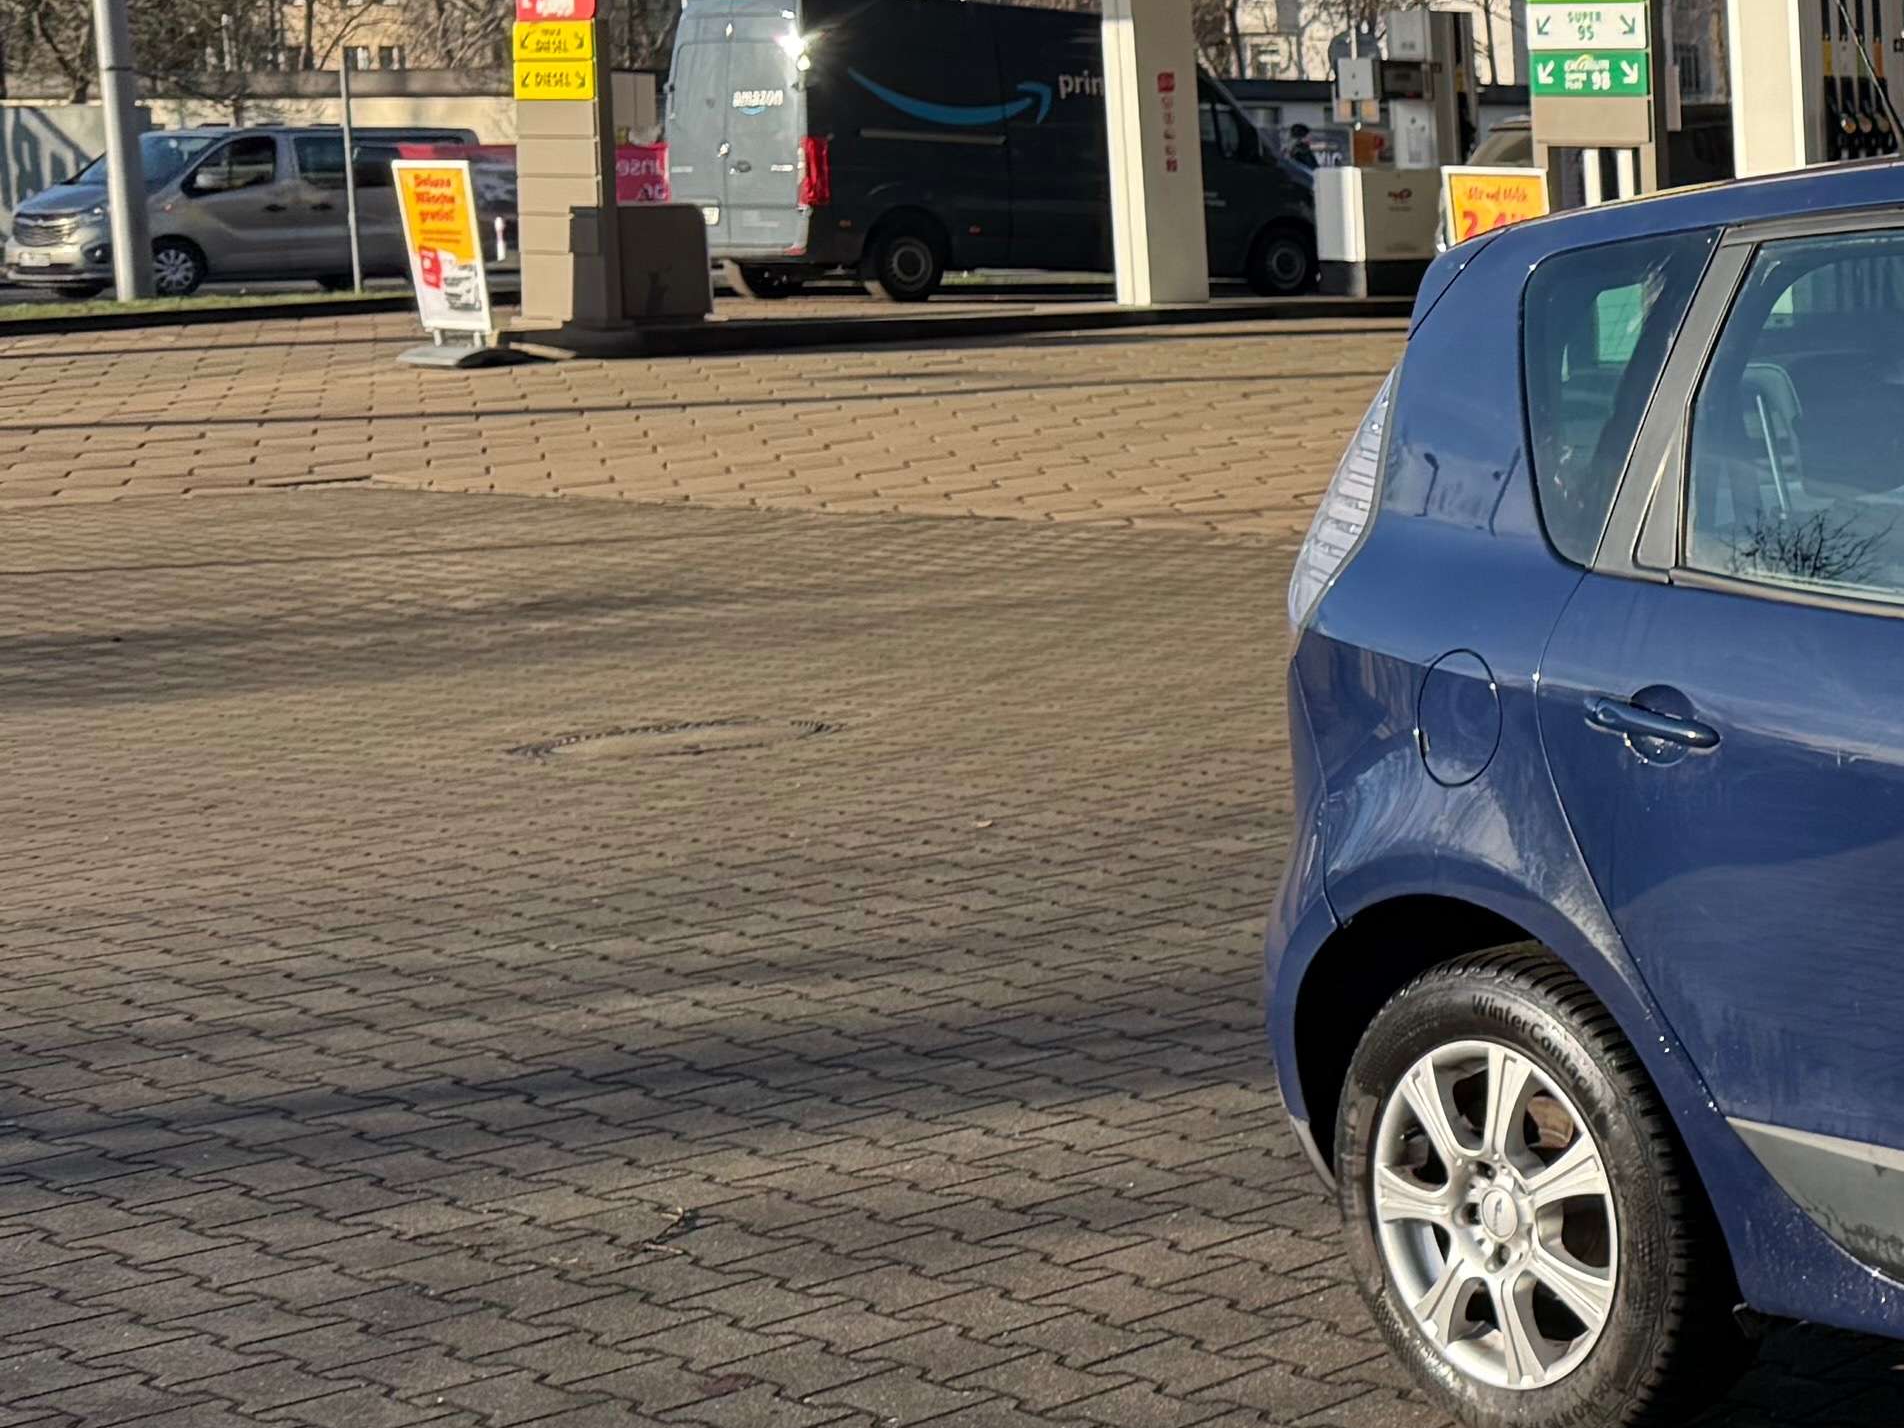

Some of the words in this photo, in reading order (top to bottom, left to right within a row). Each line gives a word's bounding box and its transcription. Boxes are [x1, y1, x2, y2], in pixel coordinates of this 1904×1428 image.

[1567, 11, 1602, 24] SUPER
[1577, 25, 1595, 41] 95
[732, 90, 784, 108] amazon
